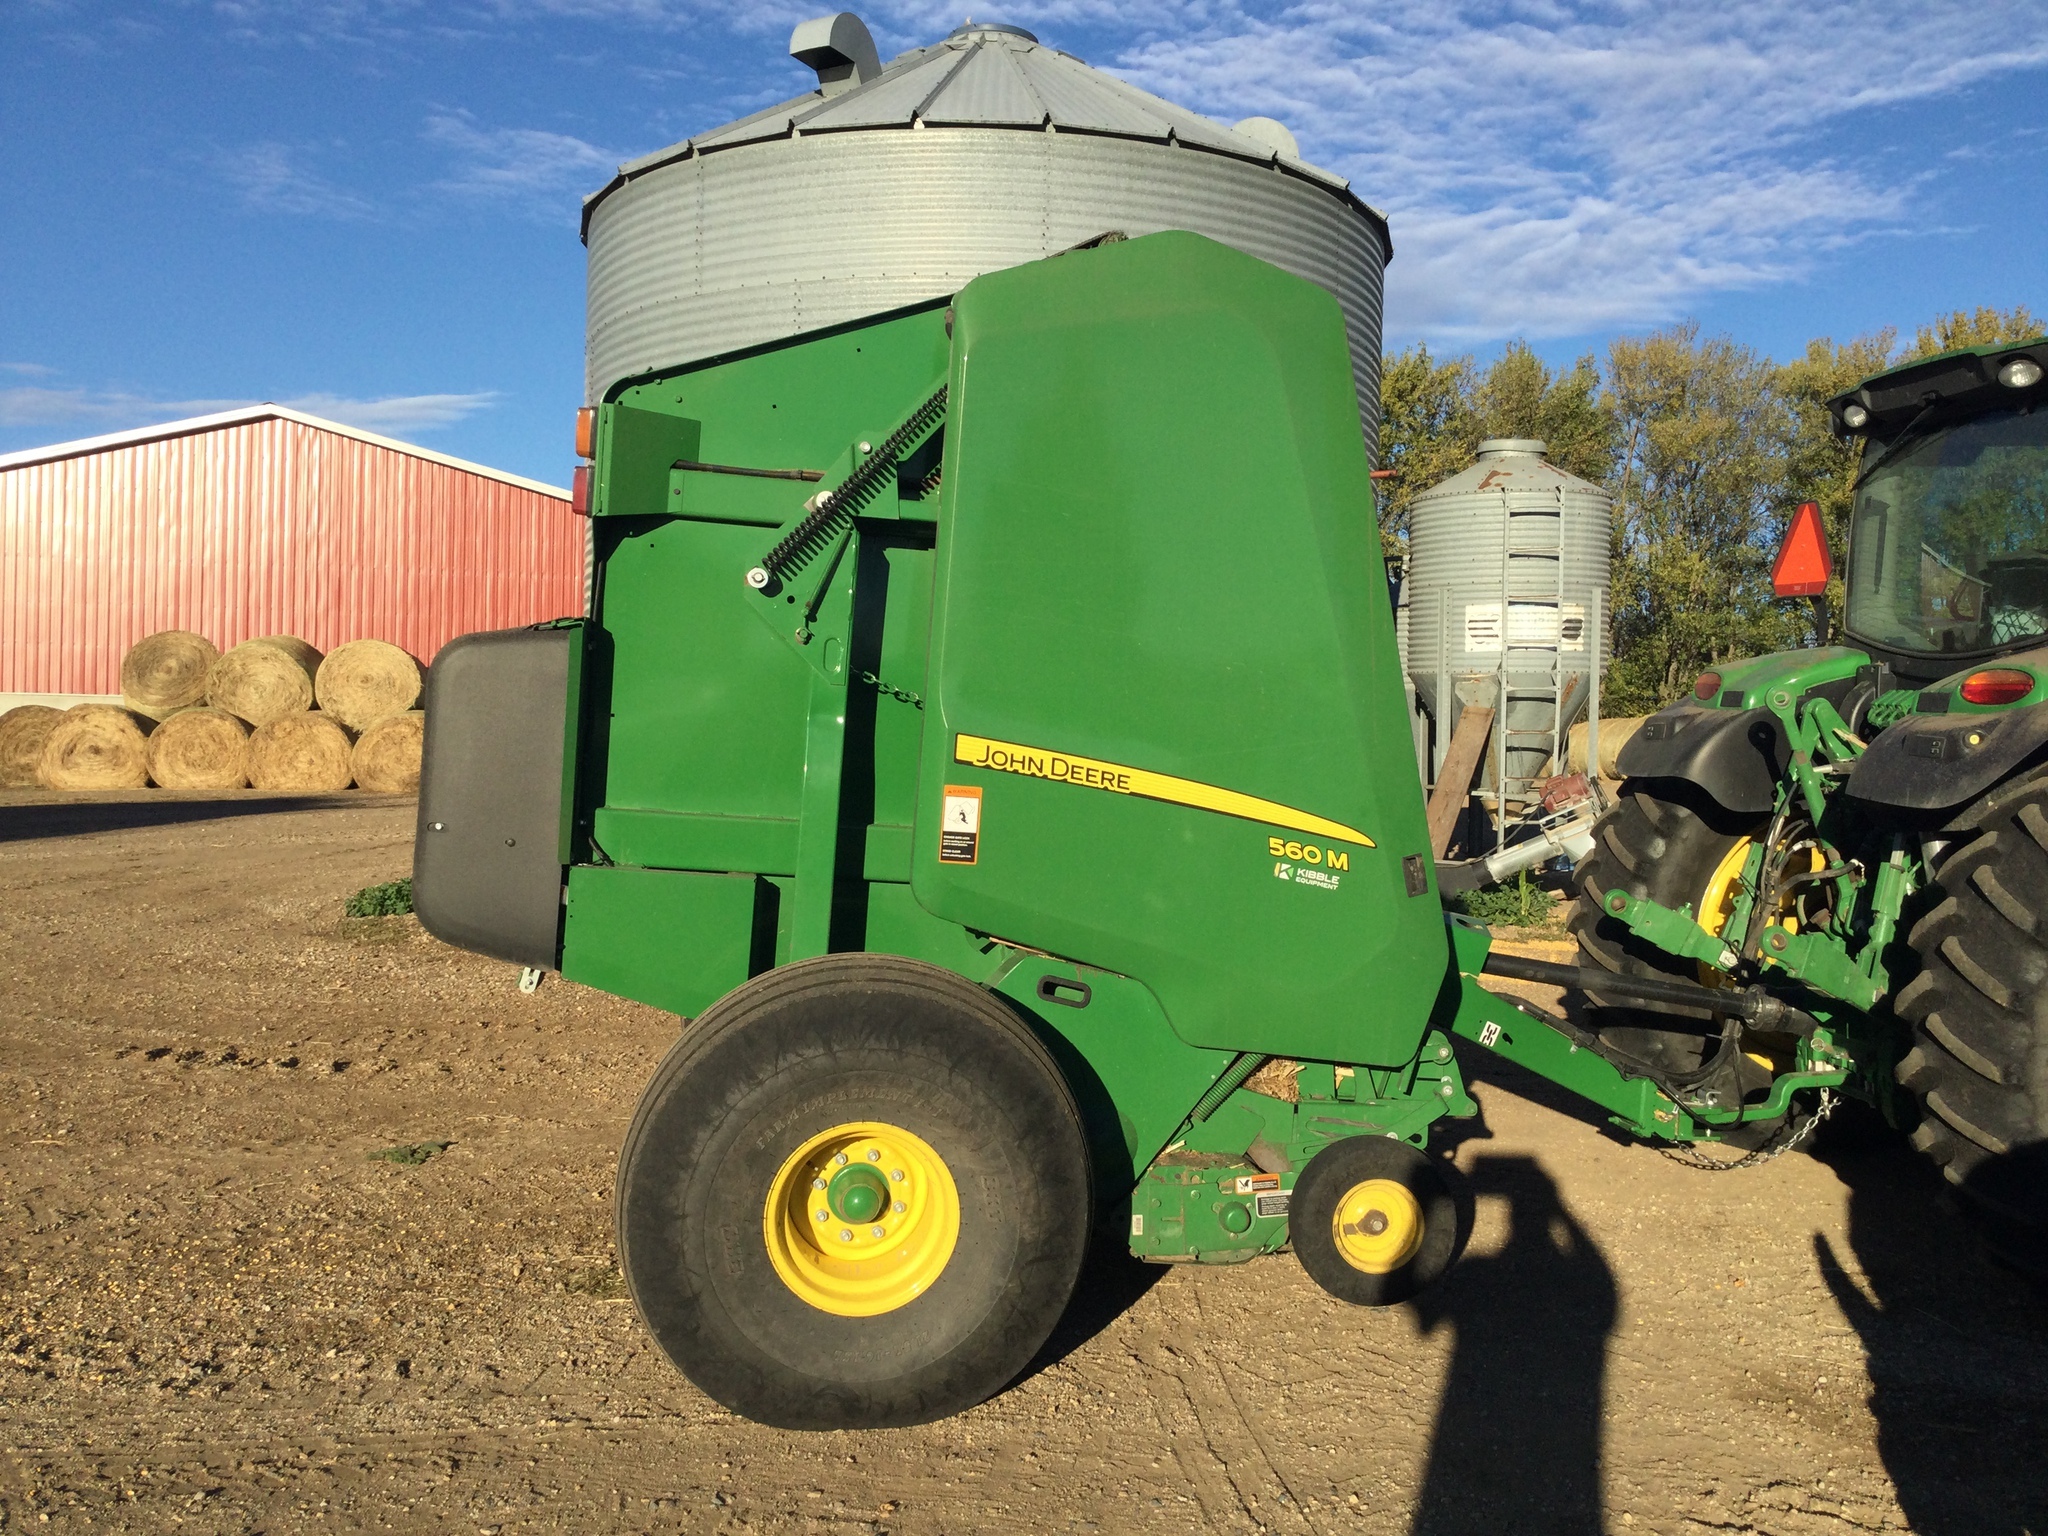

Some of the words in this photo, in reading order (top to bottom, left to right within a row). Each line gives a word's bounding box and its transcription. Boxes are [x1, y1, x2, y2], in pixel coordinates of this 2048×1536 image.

[976, 745, 1044, 774] JOHN
[1051, 757, 1131, 790] DEERE
[1268, 836, 1322, 865] 560
[1326, 848, 1349, 872] M
[1295, 876, 1339, 891] EQUIPMENT
[1296, 868, 1340, 885] KIBBLE
[756, 1107, 799, 1150] FARM
[803, 1087, 914, 1114] IMPLEMENT
